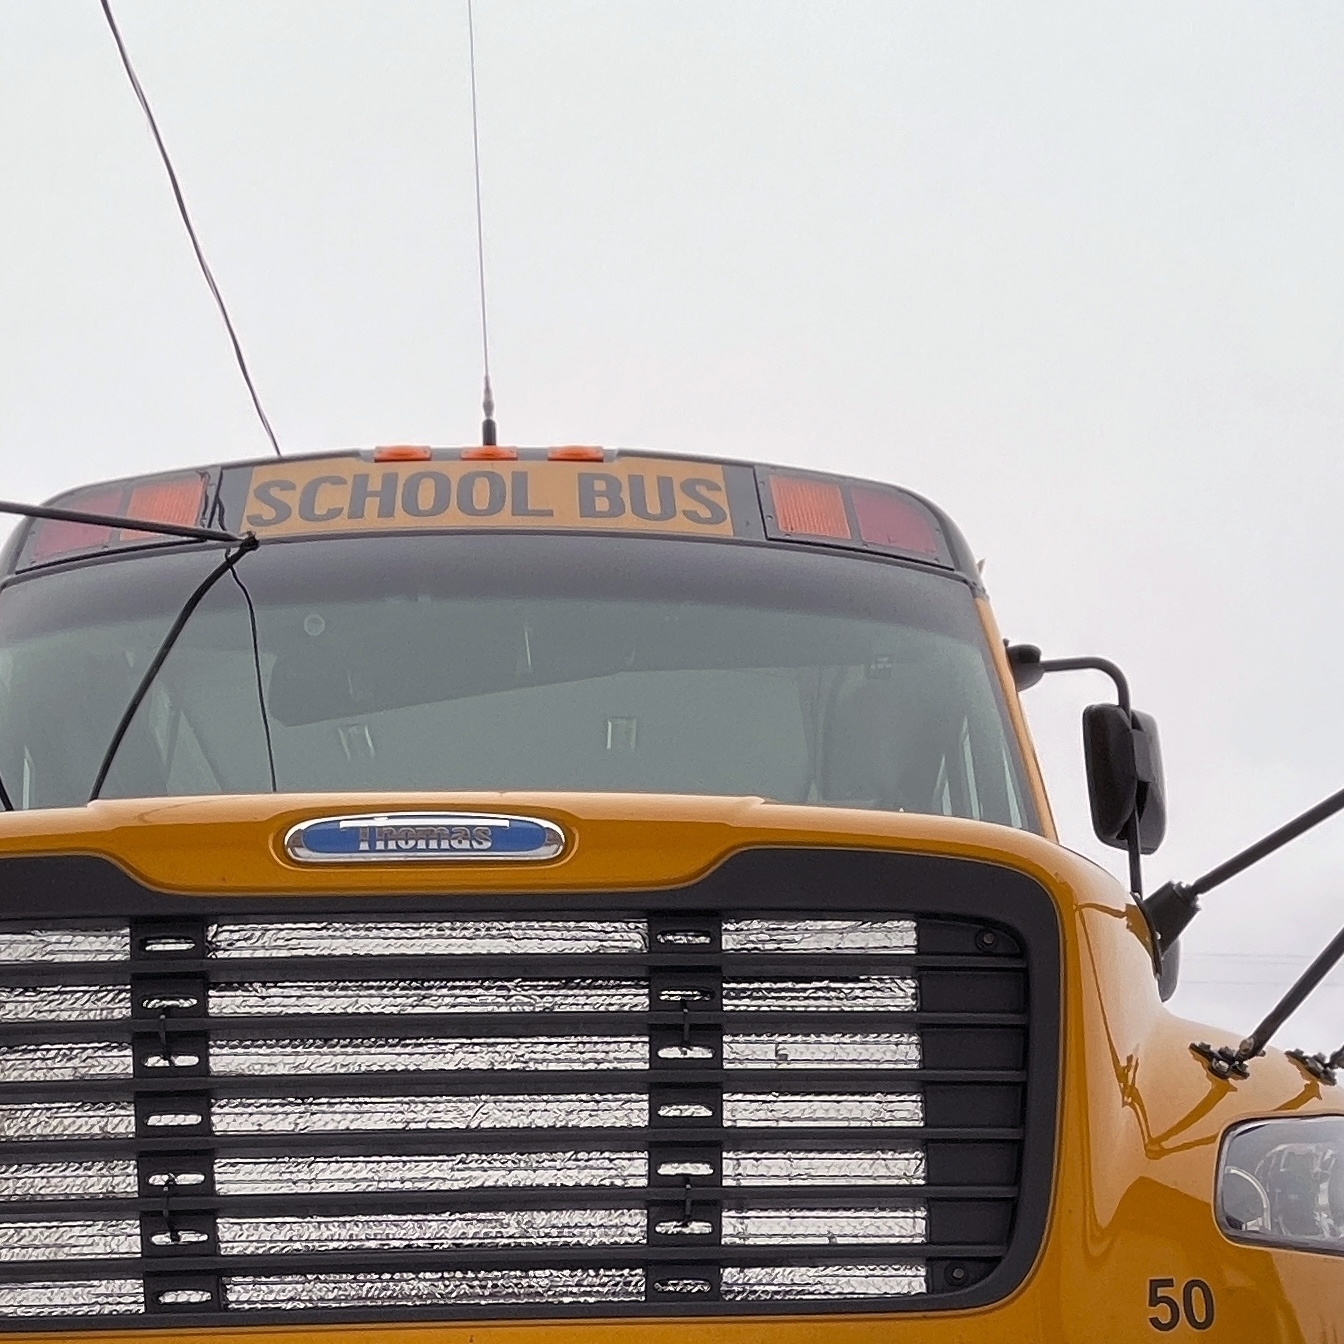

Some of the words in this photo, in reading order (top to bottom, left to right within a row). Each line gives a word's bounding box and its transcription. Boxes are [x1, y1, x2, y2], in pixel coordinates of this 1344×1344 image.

[246, 470, 555, 527] SCHOOL
[577, 472, 728, 525] BUS
[358, 826, 493, 851] Thomas
[1147, 1277, 1215, 1332] 50
